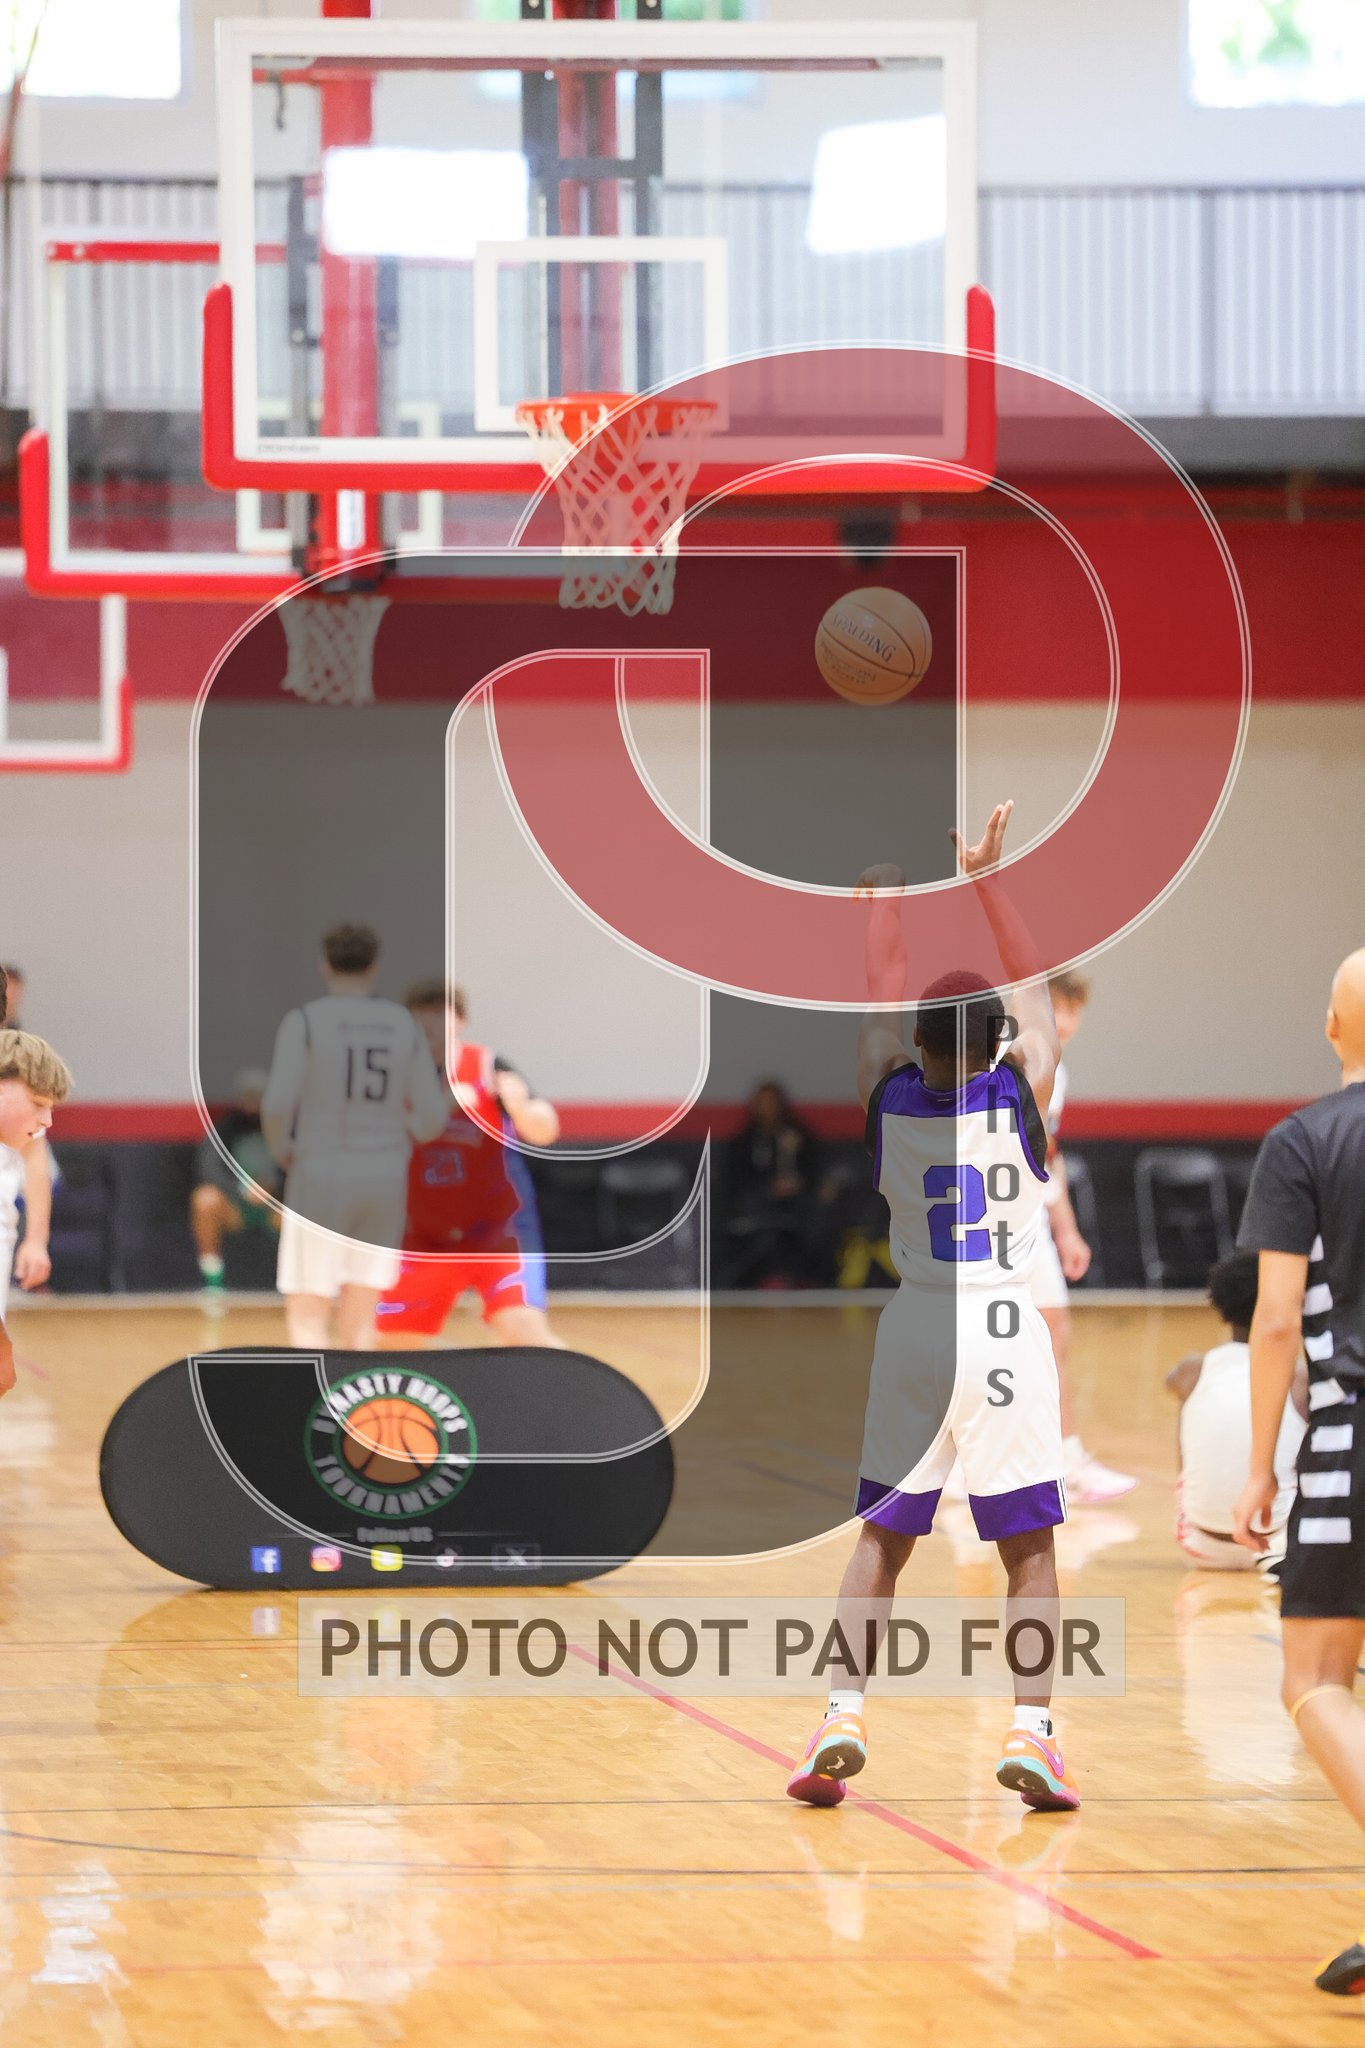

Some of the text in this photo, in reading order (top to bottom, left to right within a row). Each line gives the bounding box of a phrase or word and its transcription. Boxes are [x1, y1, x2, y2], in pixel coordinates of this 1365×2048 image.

[830, 610, 898, 663] SPALDING
[345, 1046, 390, 1103] 15
[922, 1164, 993, 1262] 2
